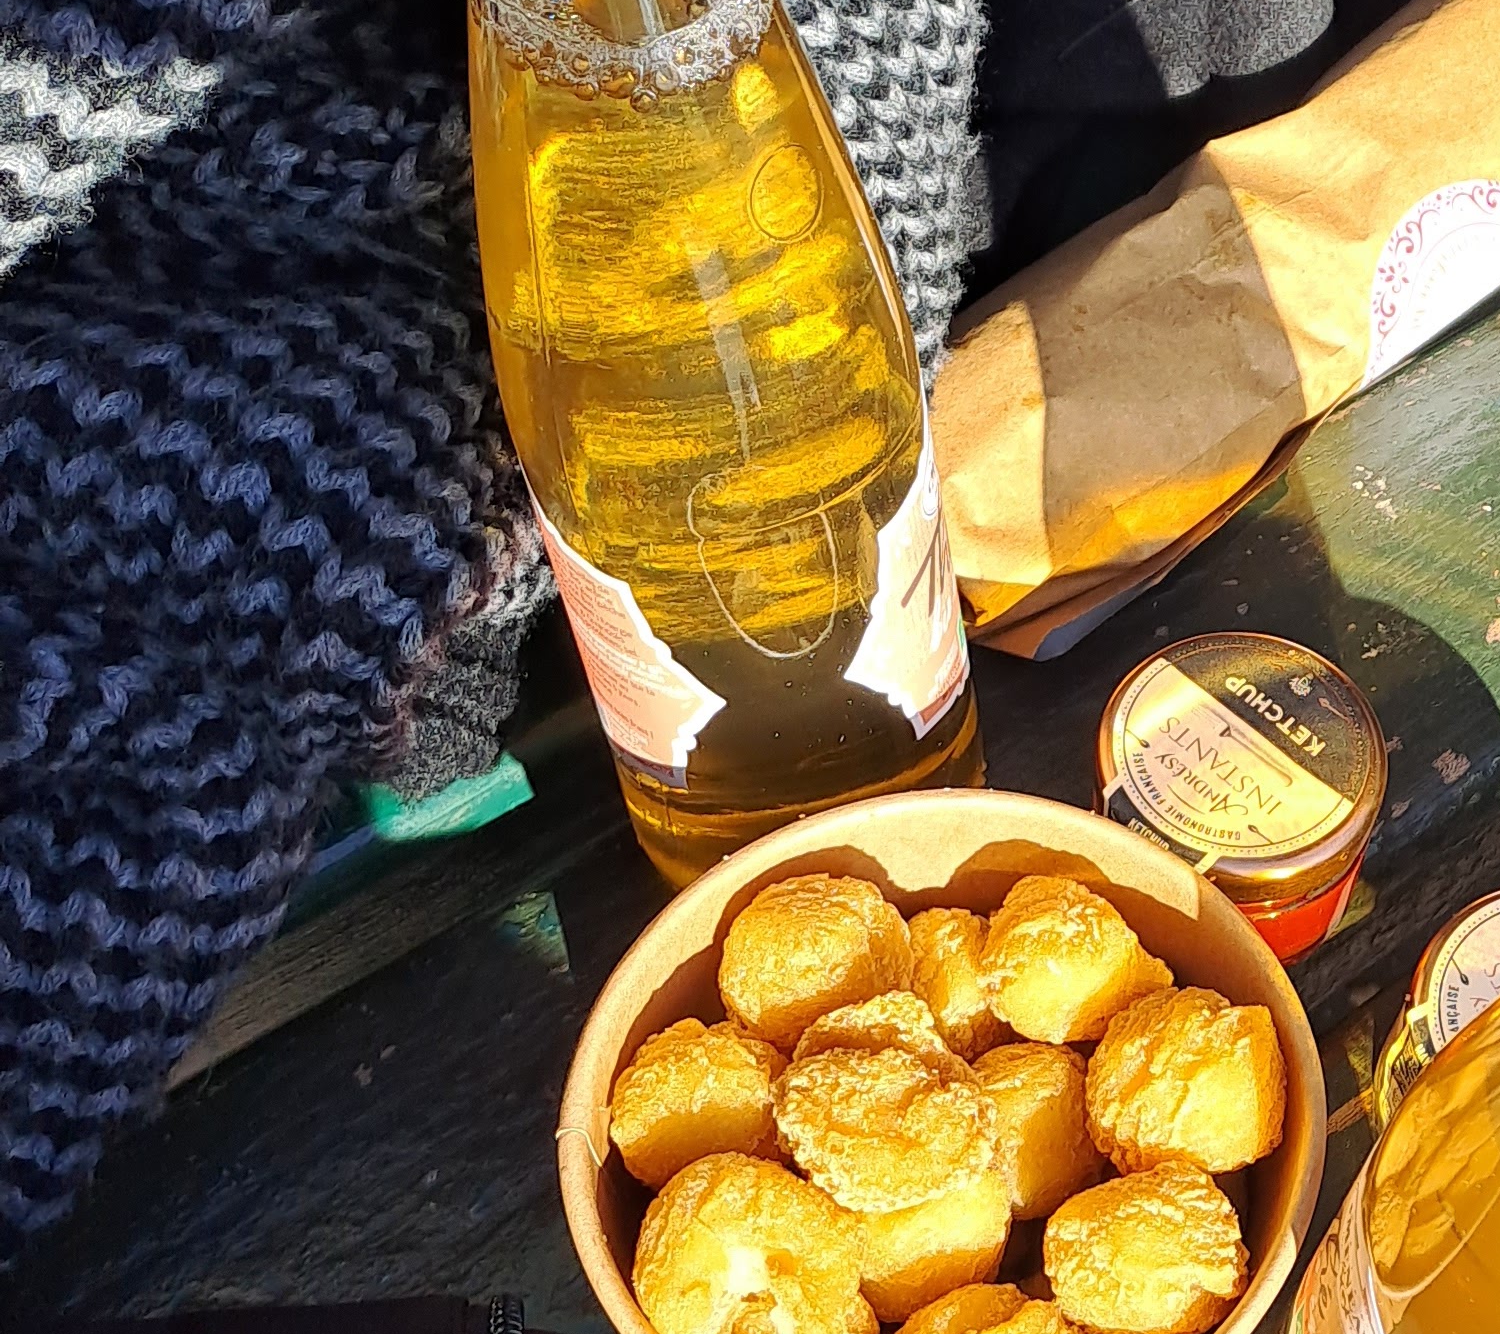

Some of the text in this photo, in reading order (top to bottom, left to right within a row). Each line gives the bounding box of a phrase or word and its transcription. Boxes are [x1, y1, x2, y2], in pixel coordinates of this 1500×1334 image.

[1225, 676, 1327, 757] KETCHUP
[1132, 752, 1242, 841] GASTRONOMIE FRANÇAISE
[1159, 716, 1282, 816] INSTANTS
